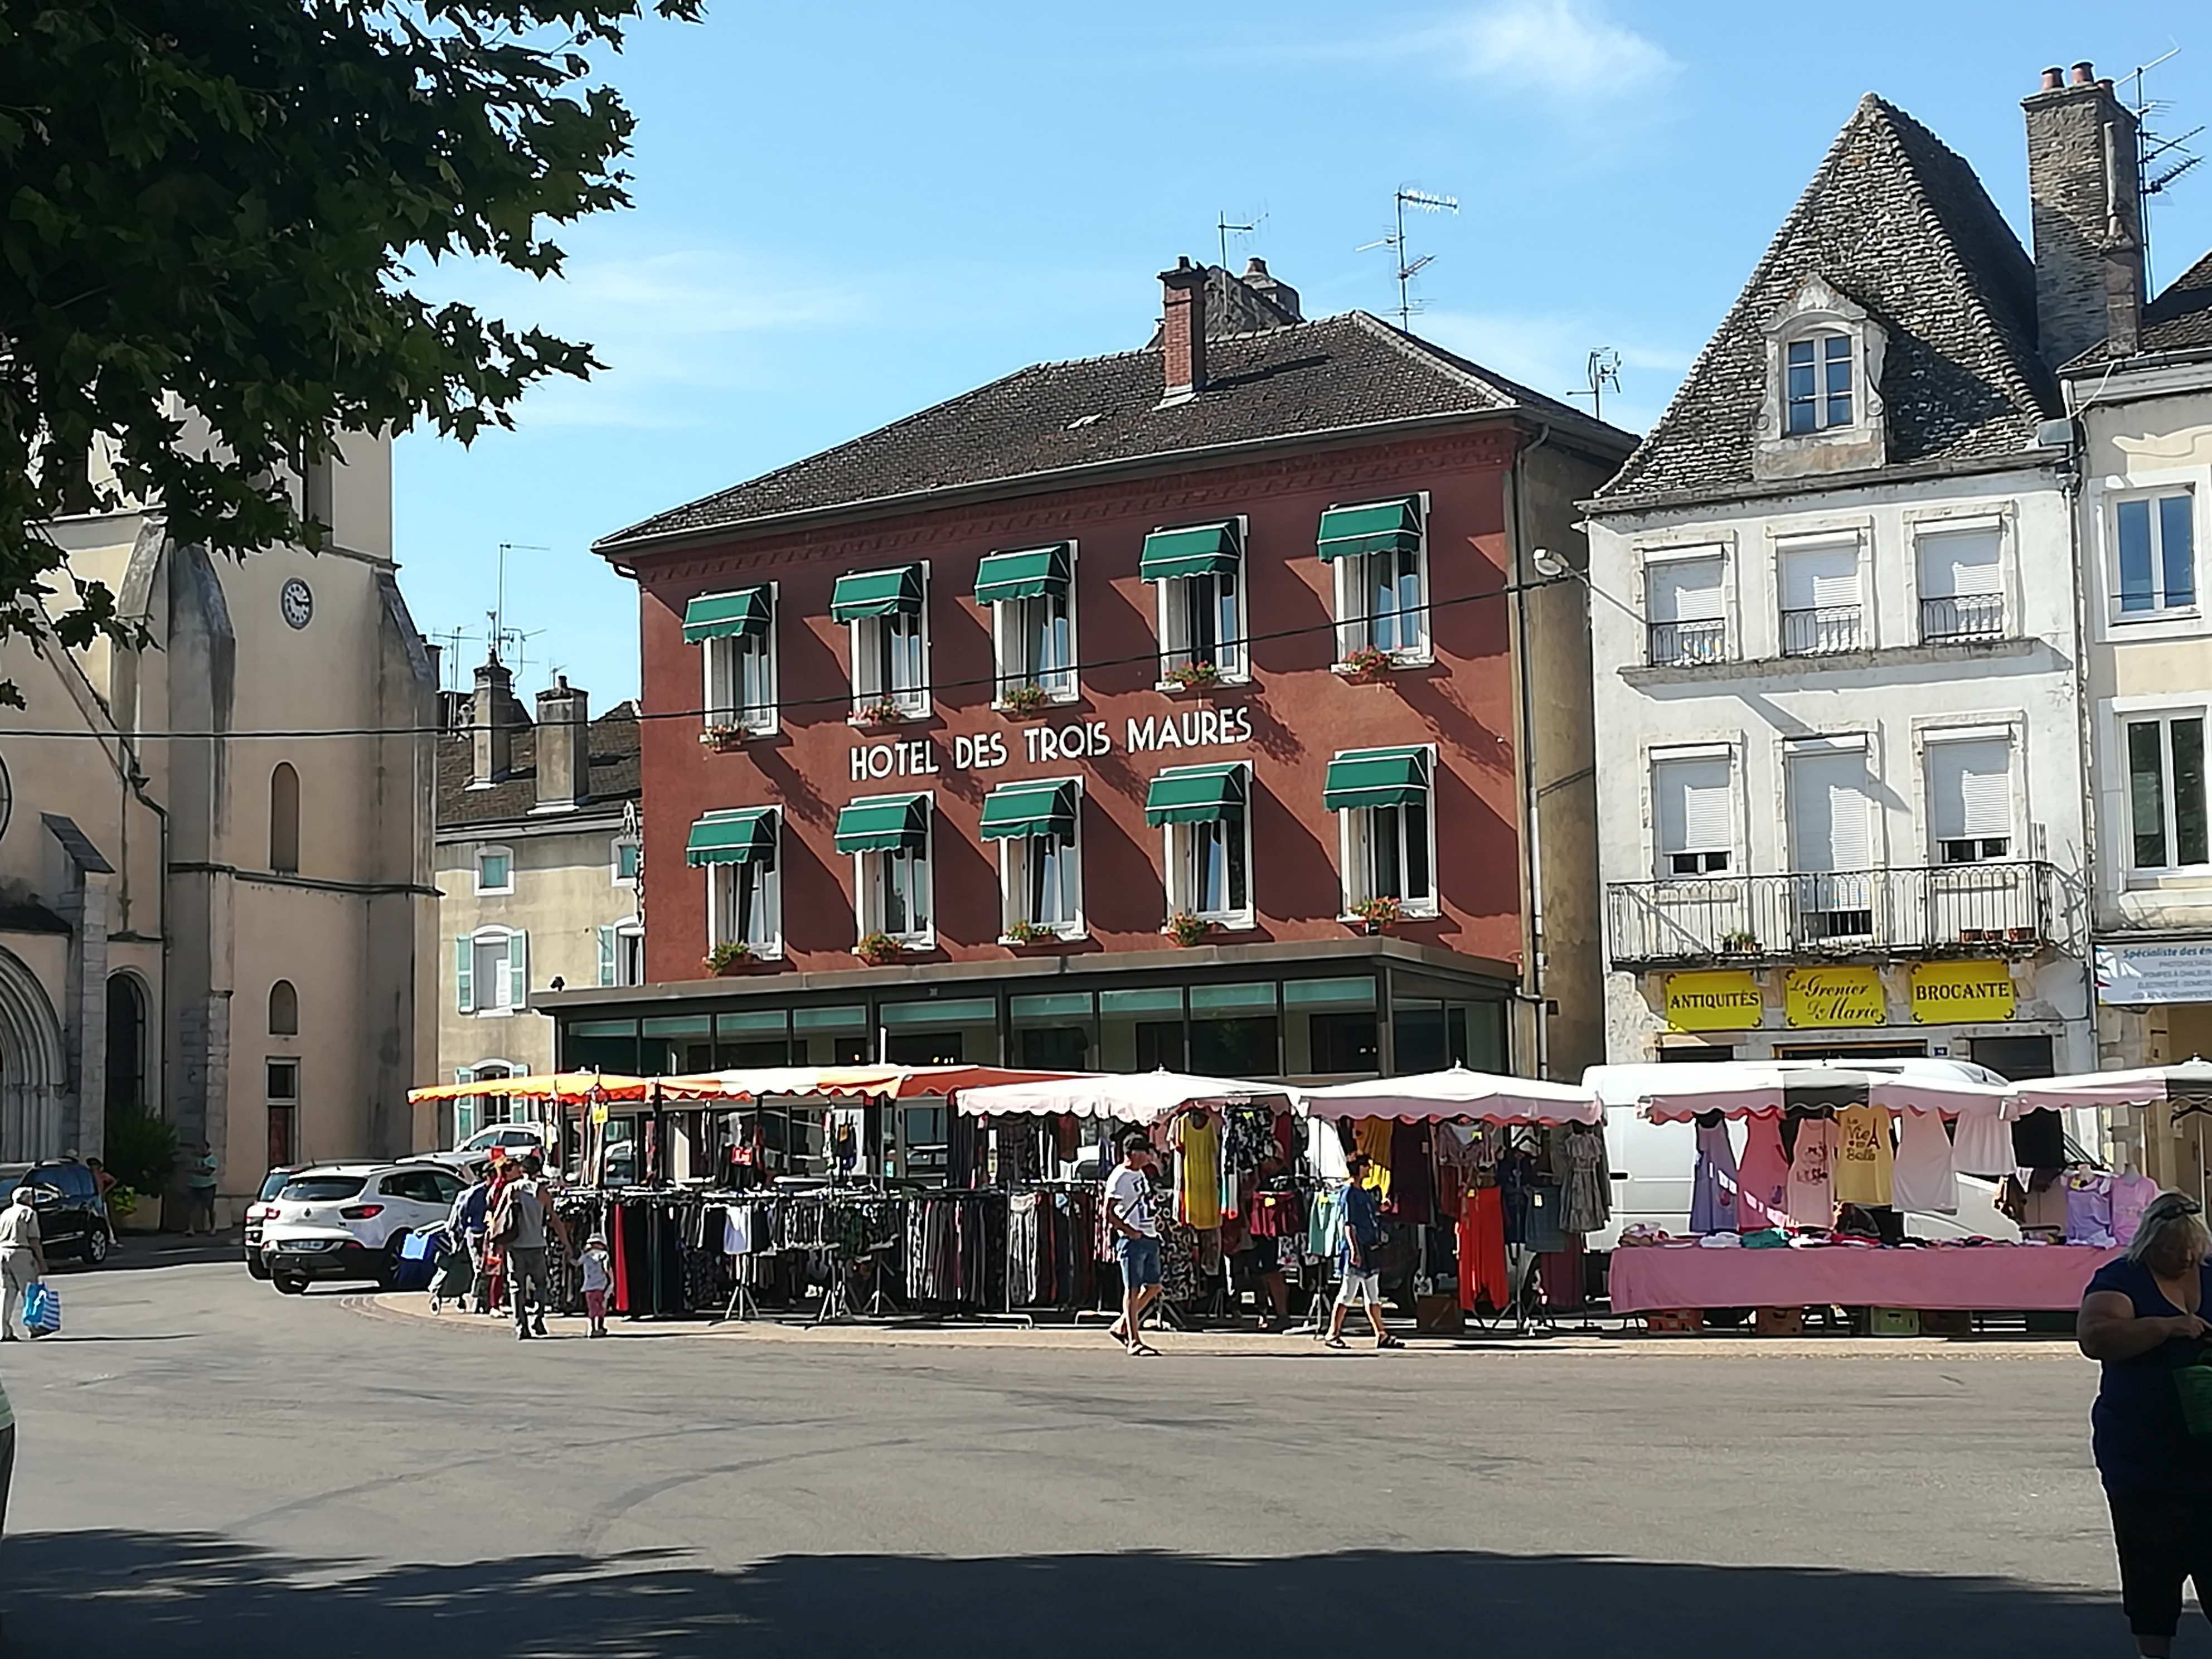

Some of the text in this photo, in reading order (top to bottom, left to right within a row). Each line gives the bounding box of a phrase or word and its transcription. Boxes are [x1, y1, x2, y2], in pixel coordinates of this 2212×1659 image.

[851, 706, 1252, 781] HOTEL DES TROIS MAURES
[2180, 947, 2197, 955] des
[1805, 974, 1869, 997] Grenier
[1915, 982, 2010, 1001] BROCANTE
[1670, 989, 1759, 1009] ANTIQUITÉS
[1828, 997, 1879, 1020] Marie
